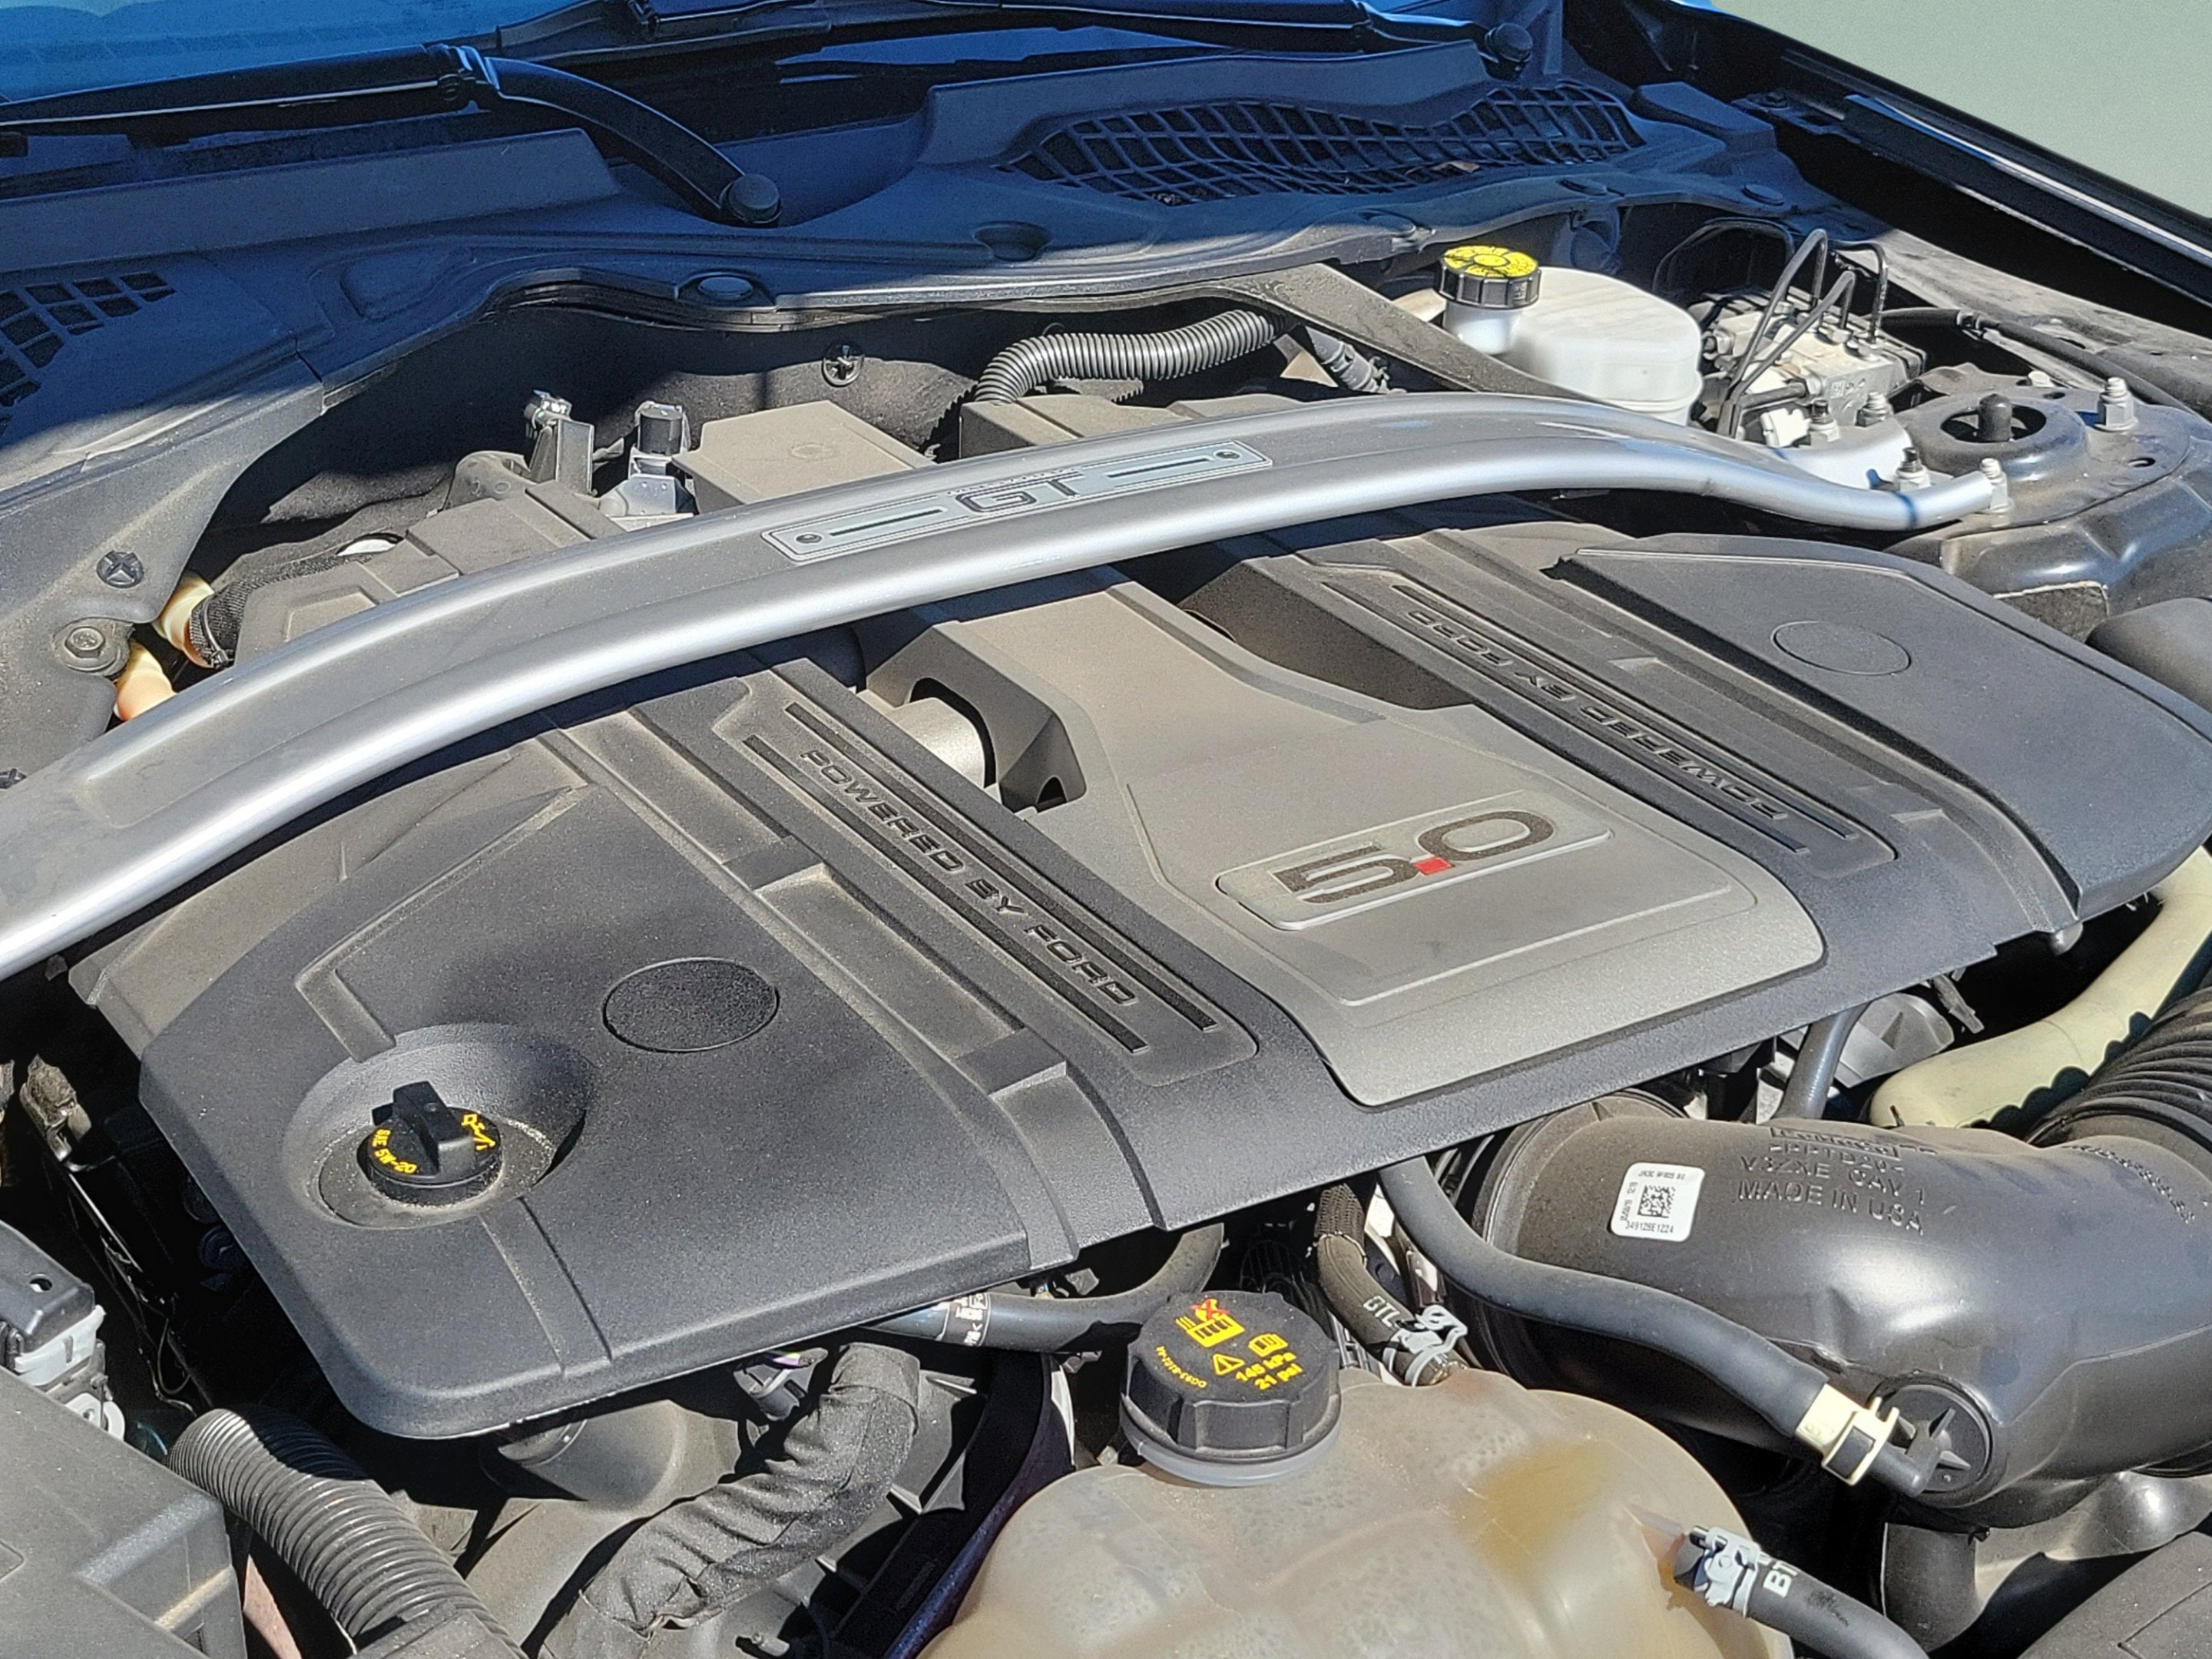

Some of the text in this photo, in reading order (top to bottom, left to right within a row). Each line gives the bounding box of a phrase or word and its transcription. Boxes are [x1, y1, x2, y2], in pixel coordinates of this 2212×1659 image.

[955, 471, 1084, 514] GT
[1408, 609, 1789, 820] POWERED BY FORD
[800, 749, 1137, 1007] POWERED BY FORD
[1271, 810, 1555, 904] 5.0
[374, 1147, 418, 1174] 5W-20
[1738, 1179, 1925, 1237] MADE IN USA
[1236, 1351, 1297, 1382] 145 kPa
[1254, 1362, 1303, 1391] 21 psi
